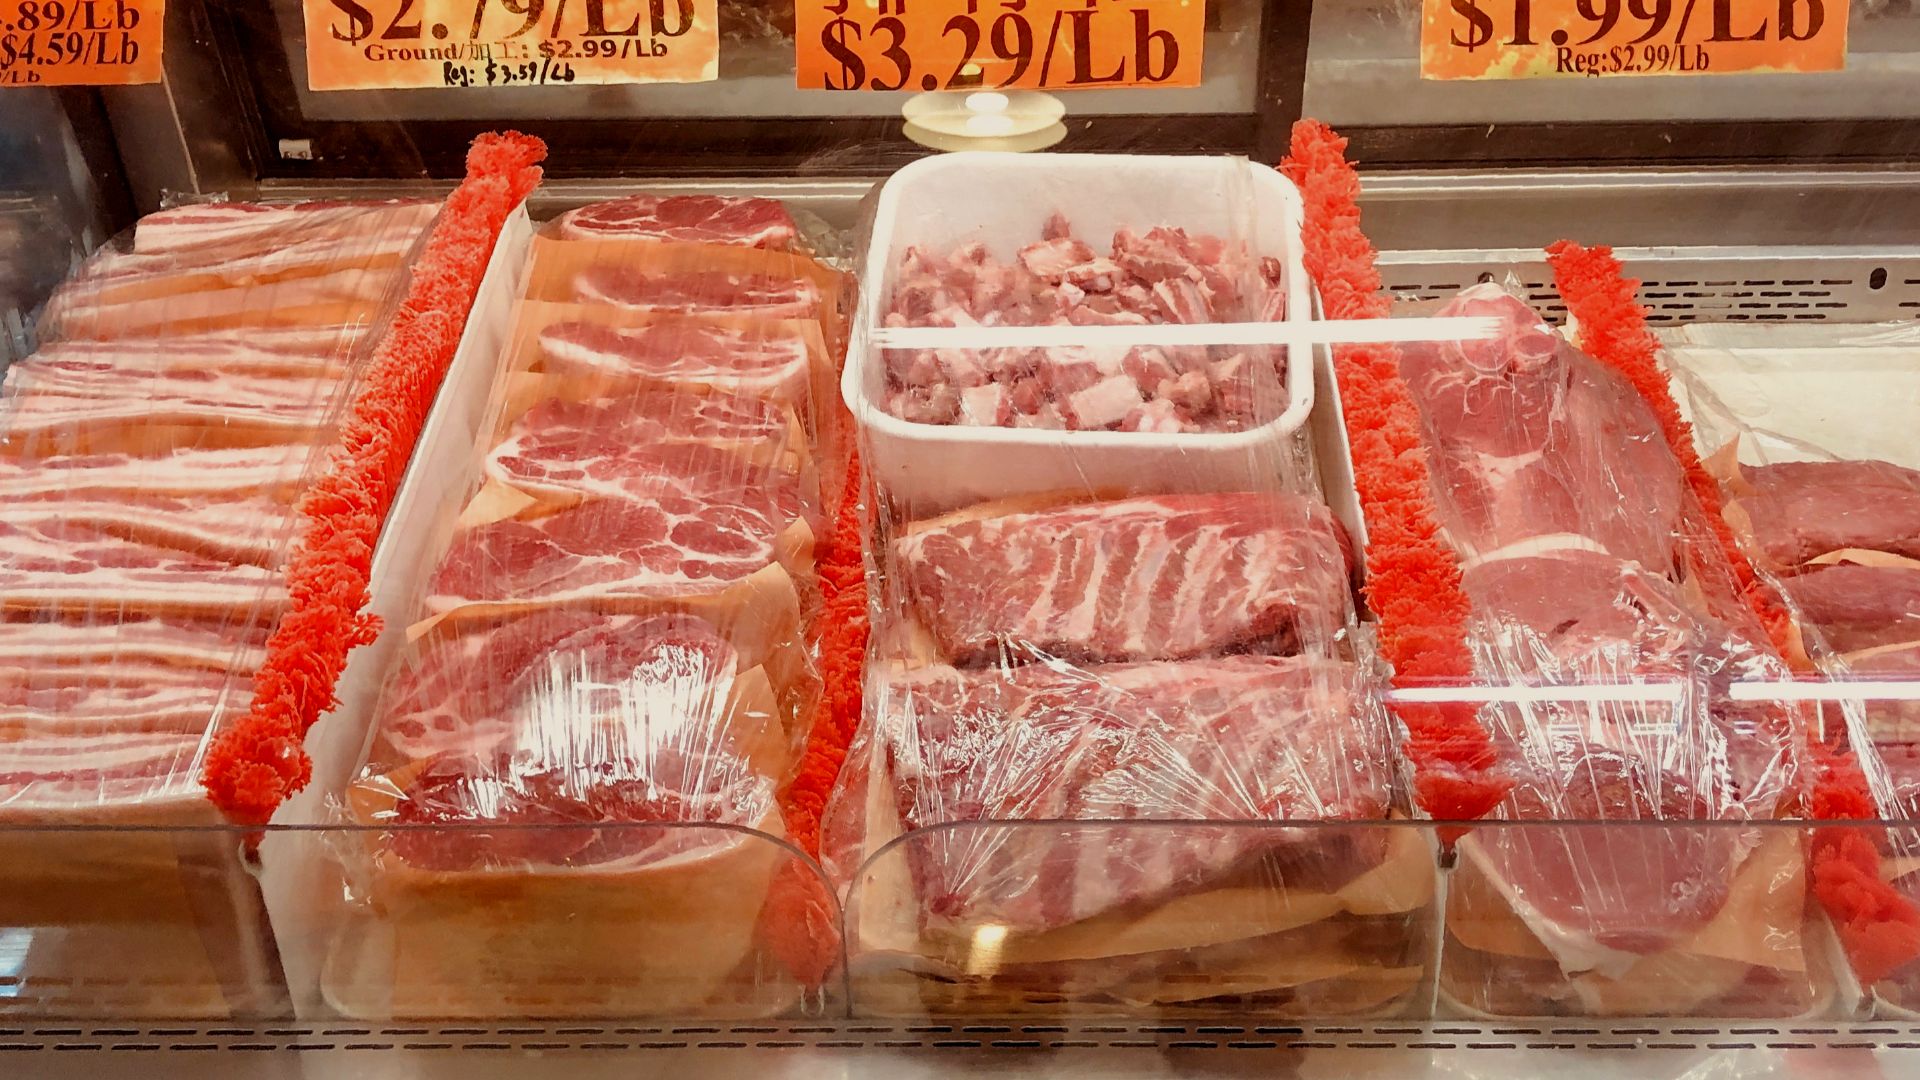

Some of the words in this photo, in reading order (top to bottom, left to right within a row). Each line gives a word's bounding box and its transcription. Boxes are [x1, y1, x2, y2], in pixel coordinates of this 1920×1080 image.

[0, 0, 140, 31] .89/Lb
[1450, 0, 1825, 53] $1.99/Lb
[538, 38, 668, 59] $2.99/Lb
[821, 9, 1179, 91] $3.29/Lb
[1556, 44, 1710, 78] Reg:$2.99/Lb
